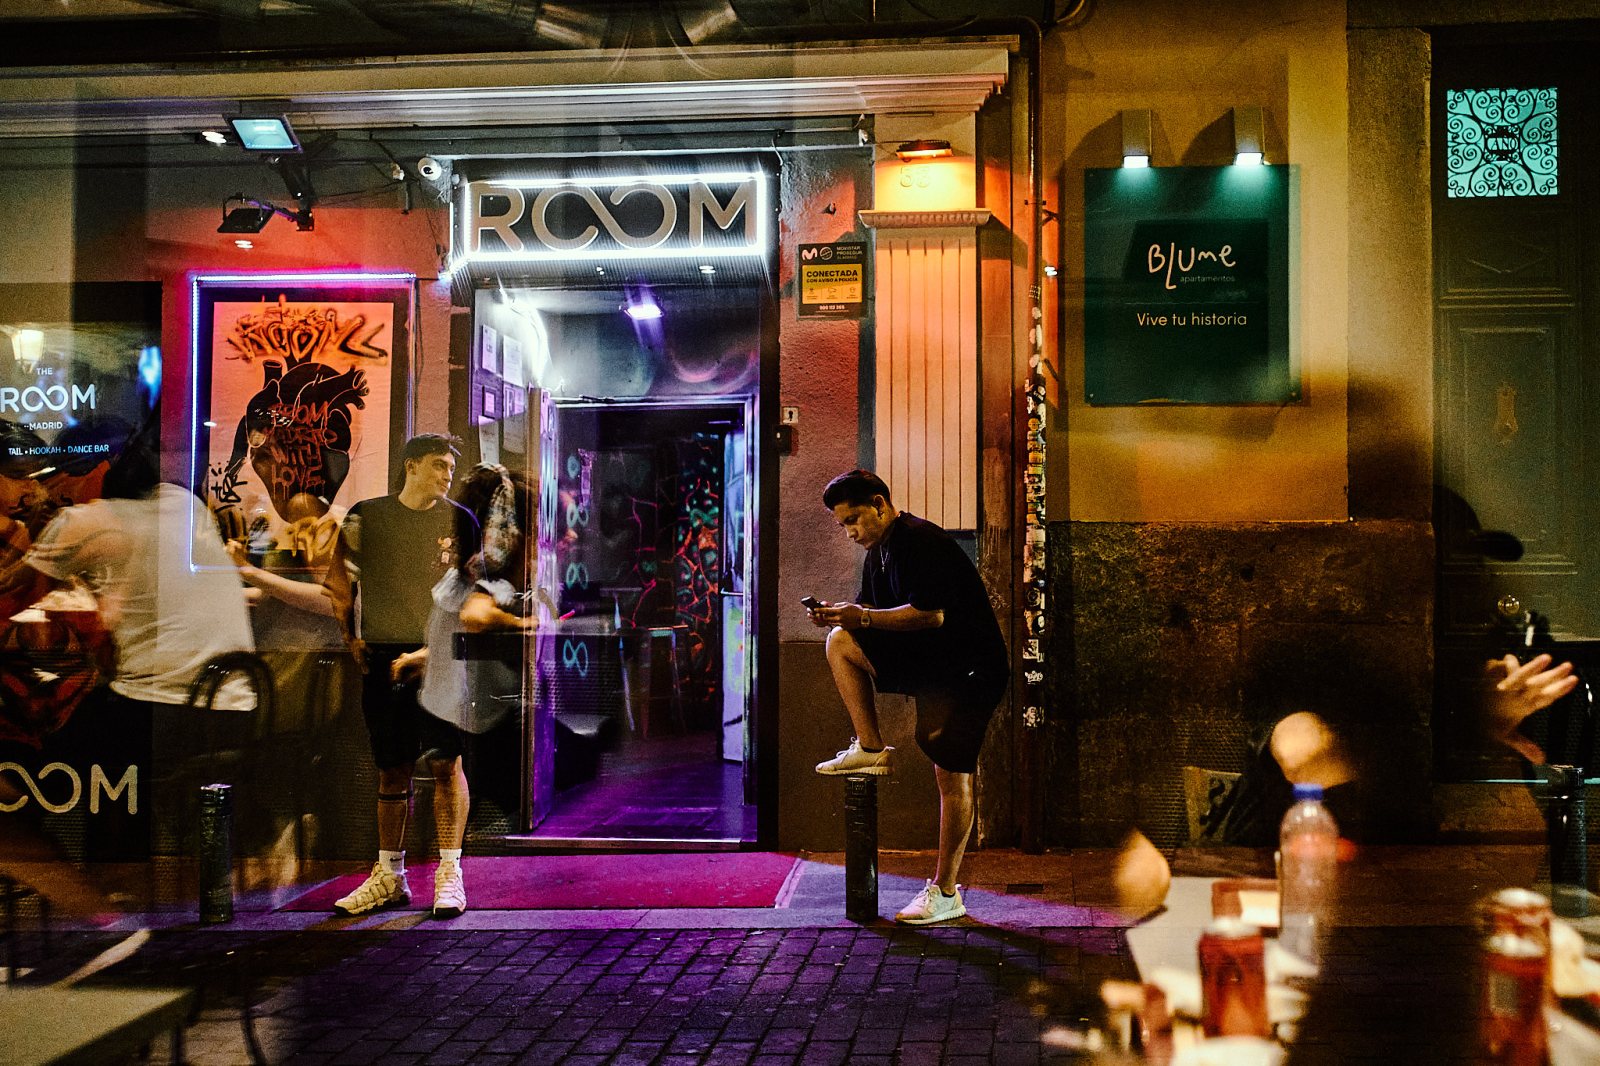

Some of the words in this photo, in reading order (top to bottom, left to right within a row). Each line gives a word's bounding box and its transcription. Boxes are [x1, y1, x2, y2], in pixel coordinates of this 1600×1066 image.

[470, 176, 758, 253] ROOM
[806, 269, 858, 278] CONECTADA
[1179, 274, 1236, 283] apartamentos
[1136, 312, 1168, 326] Vive
[1172, 312, 1186, 326] tu
[1191, 311, 1248, 326] historia
[36, 367, 53, 376] THE
[0, 383, 97, 413] ROOM
[29, 446, 62, 455] HOOKAH
[67, 445, 93, 454] DANCE
[94, 444, 110, 453] BAR
